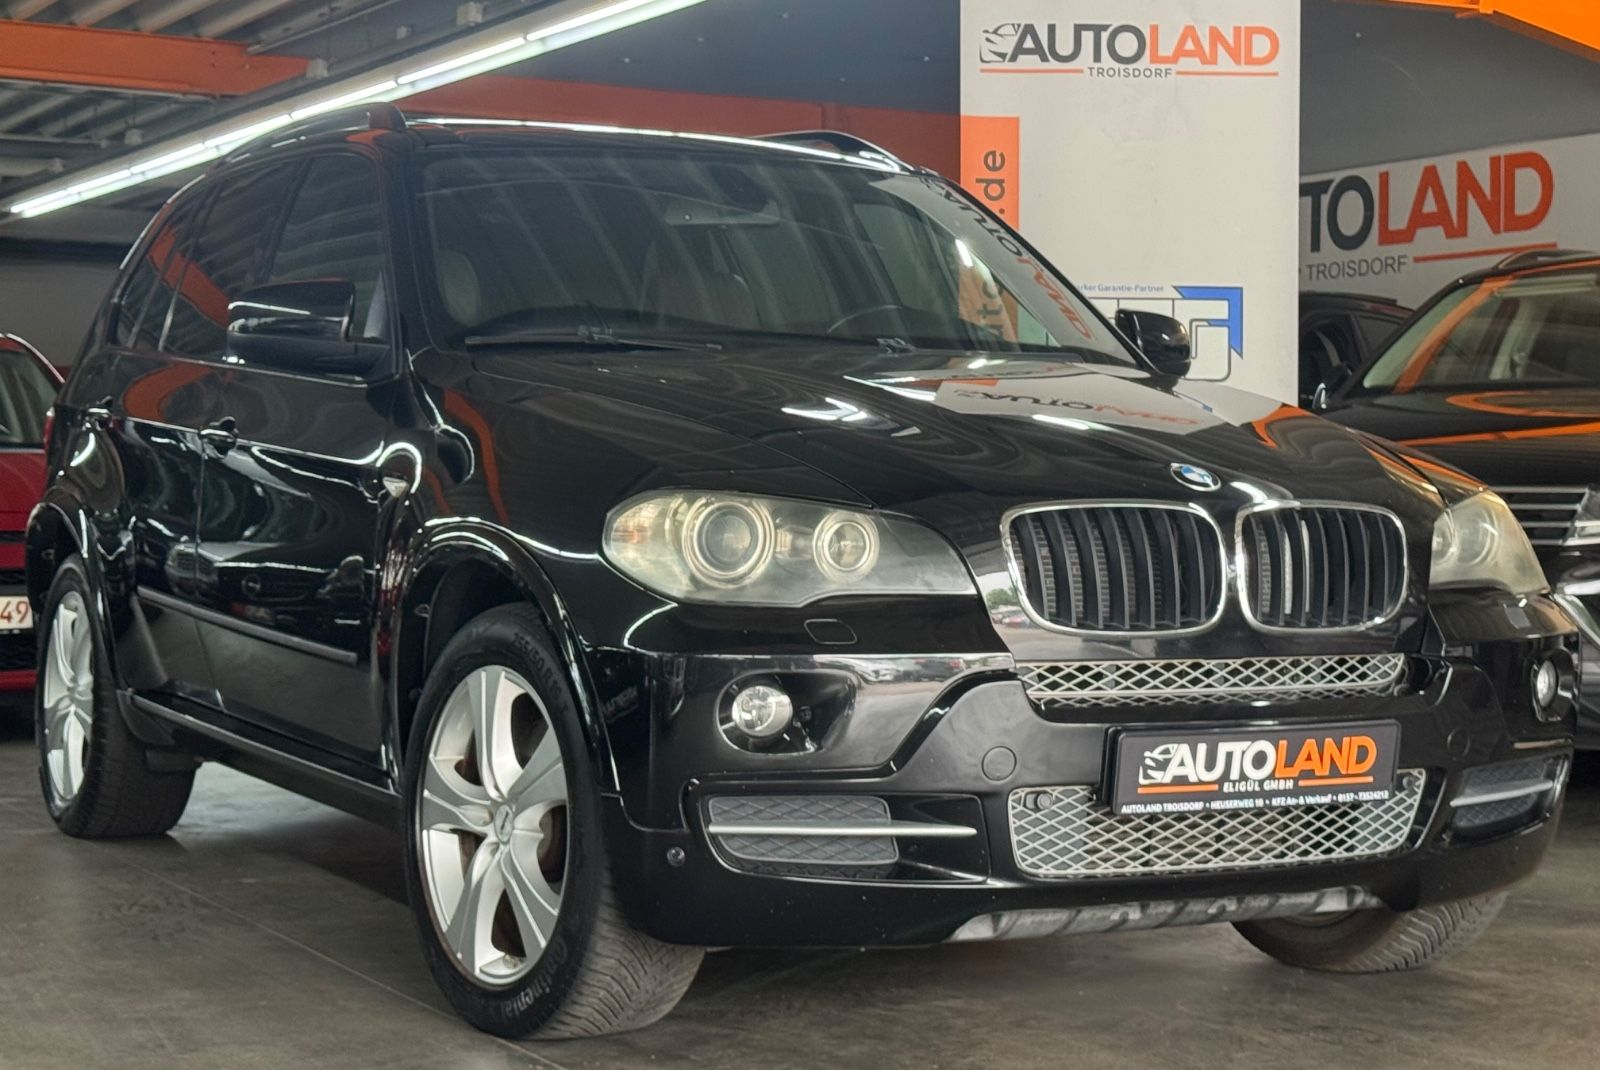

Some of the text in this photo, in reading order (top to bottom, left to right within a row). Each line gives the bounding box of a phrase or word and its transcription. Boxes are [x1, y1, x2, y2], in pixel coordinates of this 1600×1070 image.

[1007, 22, 1280, 66] AUTOLAND
[1087, 66, 1173, 79] TROISDORF
[975, 150, 1006, 215] .de
[1299, 150, 1555, 254] TOLAND
[1306, 254, 1408, 281] TROISDORF
[1097, 283, 1164, 293] Garantie-Partner
[1161, 735, 1378, 784] AUTOLAND
[1263, 778, 1294, 792] GMBH
[1121, 803, 1163, 815] AUTOLAND
[1163, 801, 1204, 813] TROISDORF
